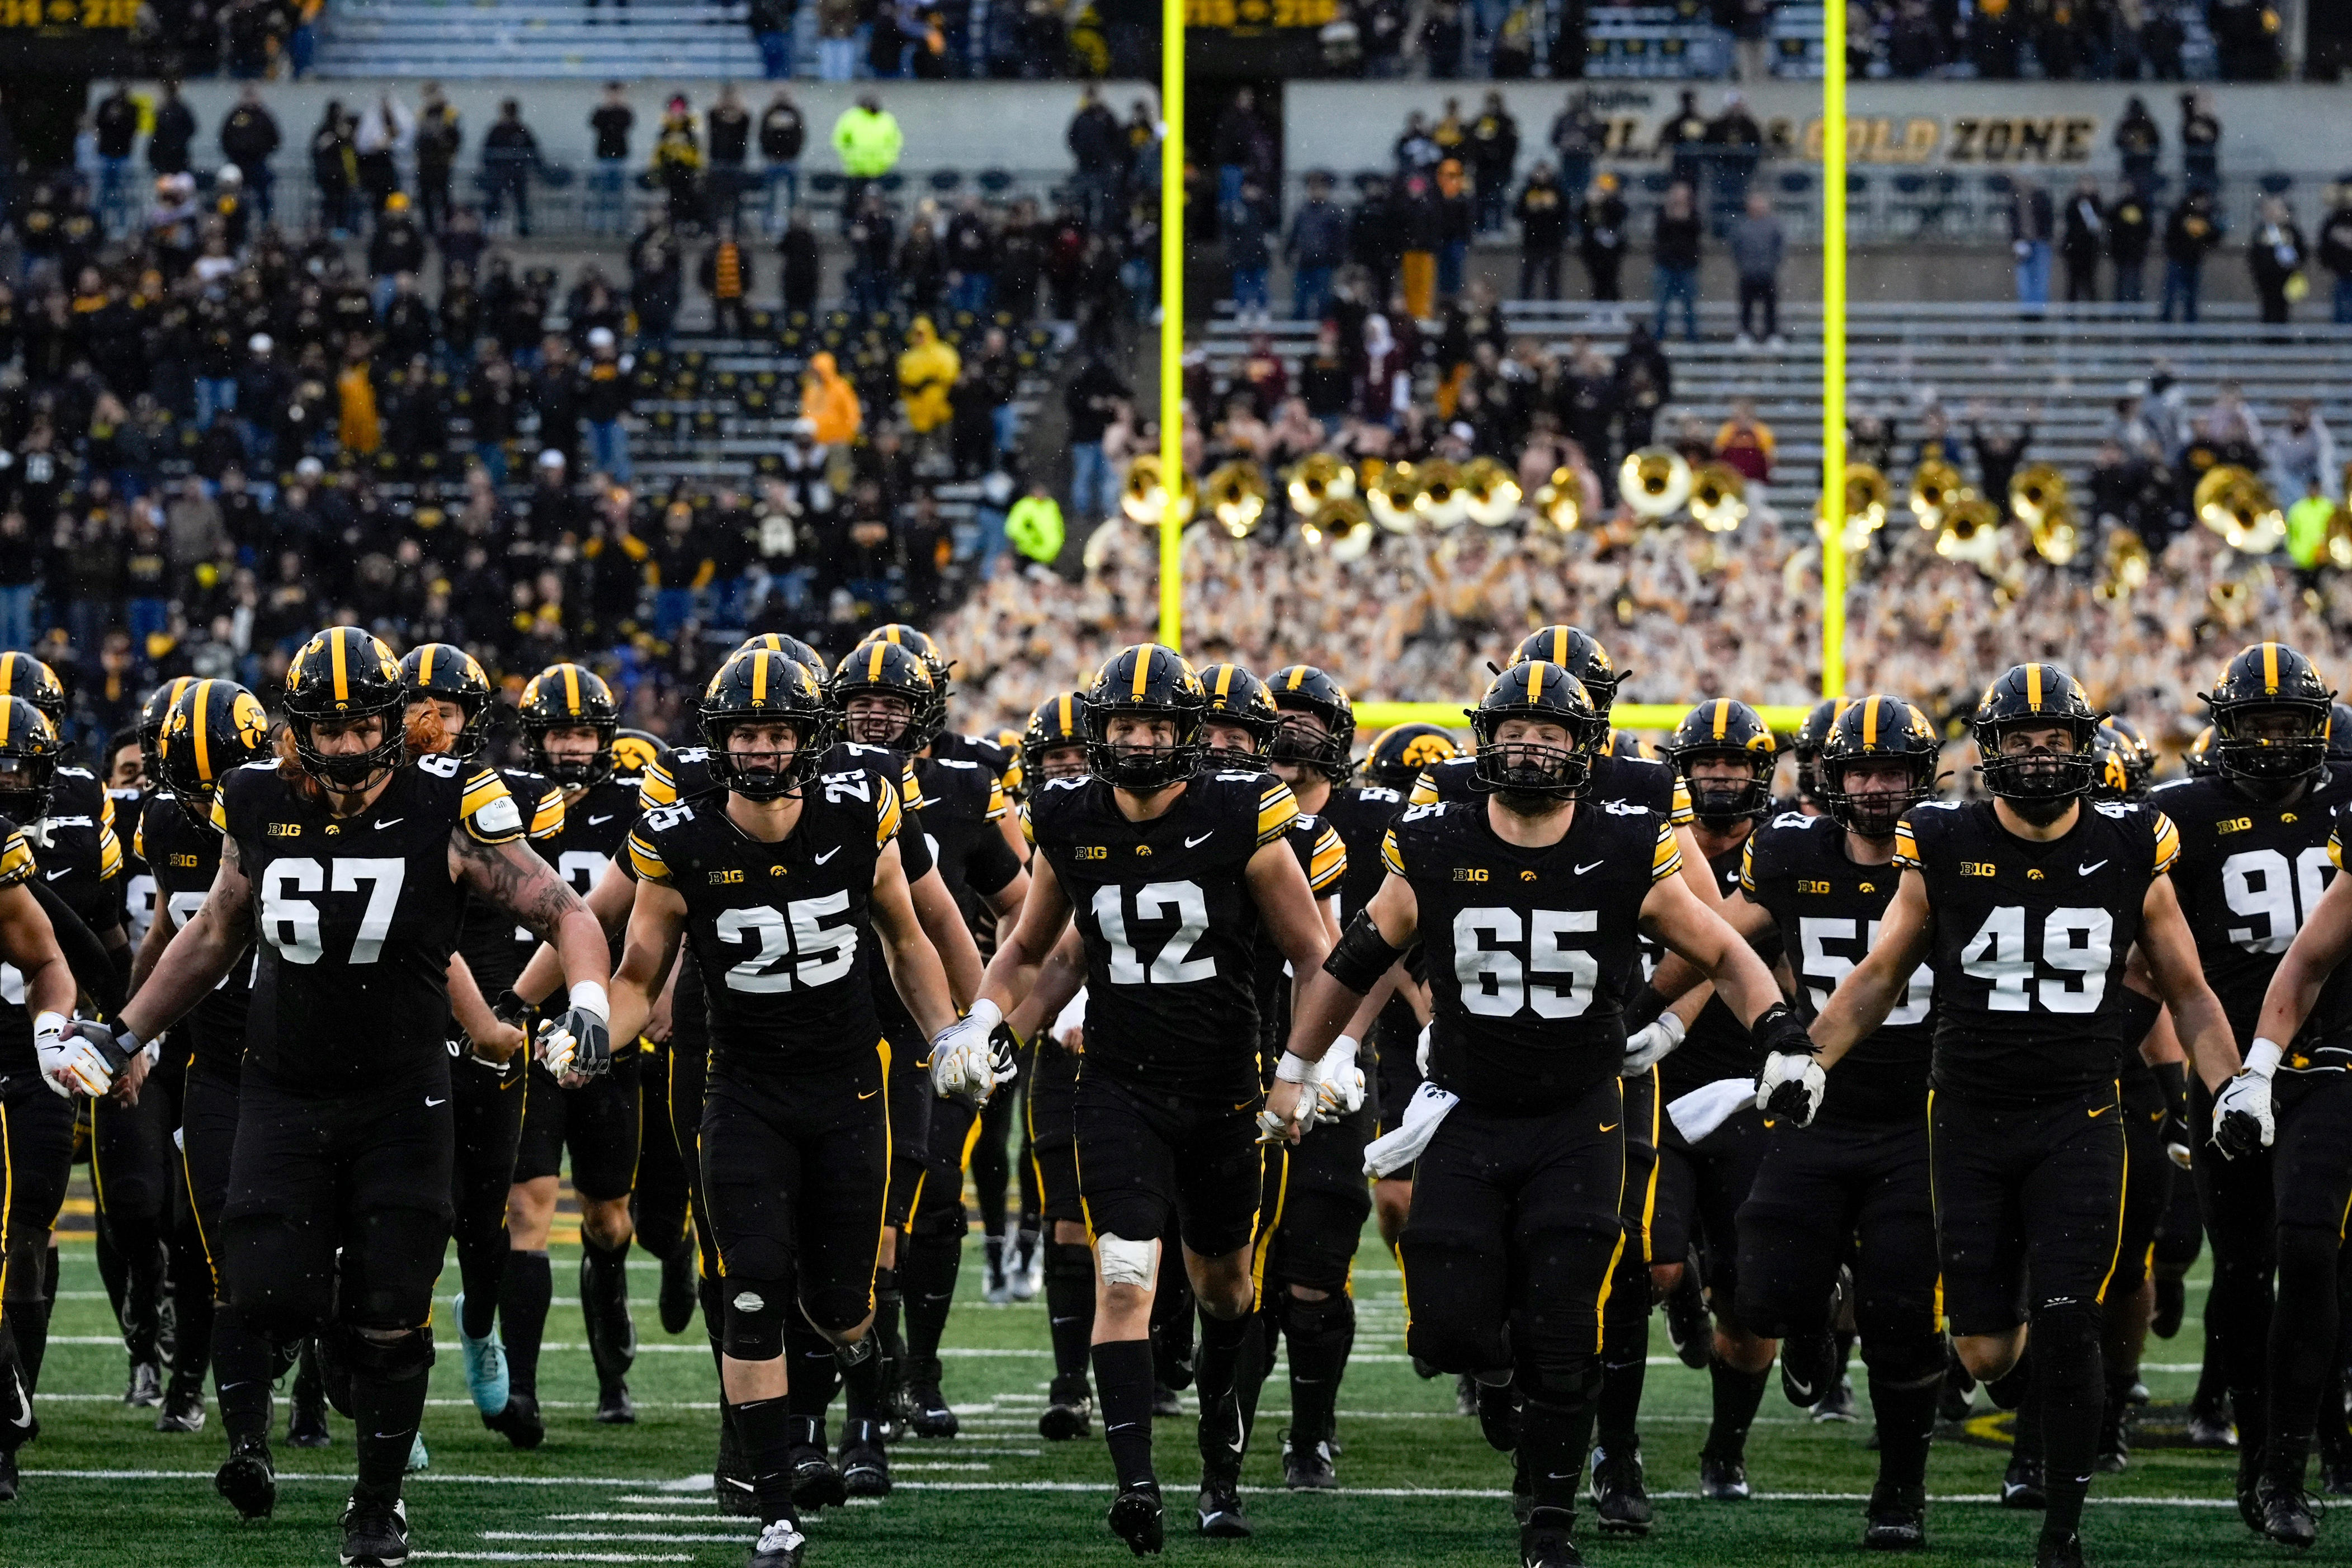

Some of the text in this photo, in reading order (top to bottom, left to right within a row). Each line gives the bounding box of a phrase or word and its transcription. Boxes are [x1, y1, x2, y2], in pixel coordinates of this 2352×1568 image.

[1946, 116, 2093, 162] ZONE
[261, 857, 405, 965] 67
[716, 889, 859, 993] 25
[1091, 880, 1217, 985] 12
[1453, 906, 1599, 1019] 65
[1961, 905, 2114, 1013] 49
